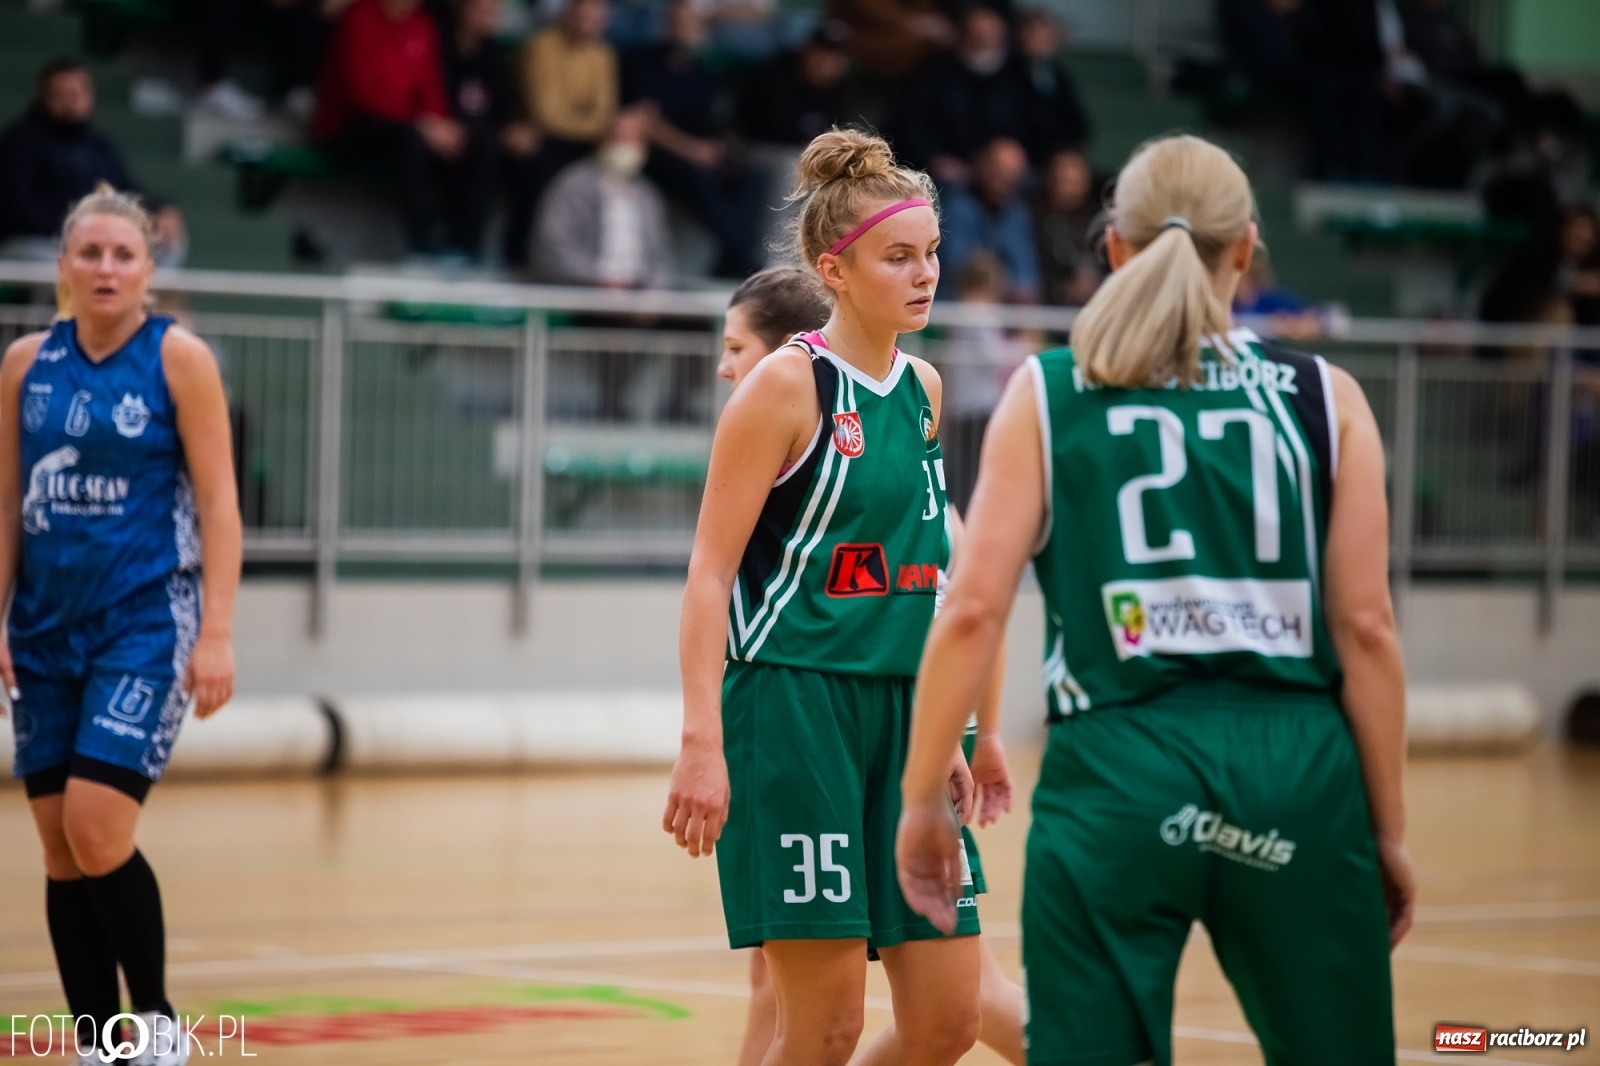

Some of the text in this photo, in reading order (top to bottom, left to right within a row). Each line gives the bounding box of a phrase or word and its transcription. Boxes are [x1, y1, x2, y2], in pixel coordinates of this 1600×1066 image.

[64, 389, 92, 437] 6
[1106, 404, 1281, 564] 27
[830, 550, 880, 591] K
[107, 673, 154, 724] 6
[1192, 810, 1296, 865] Davis
[780, 833, 851, 903] 35
